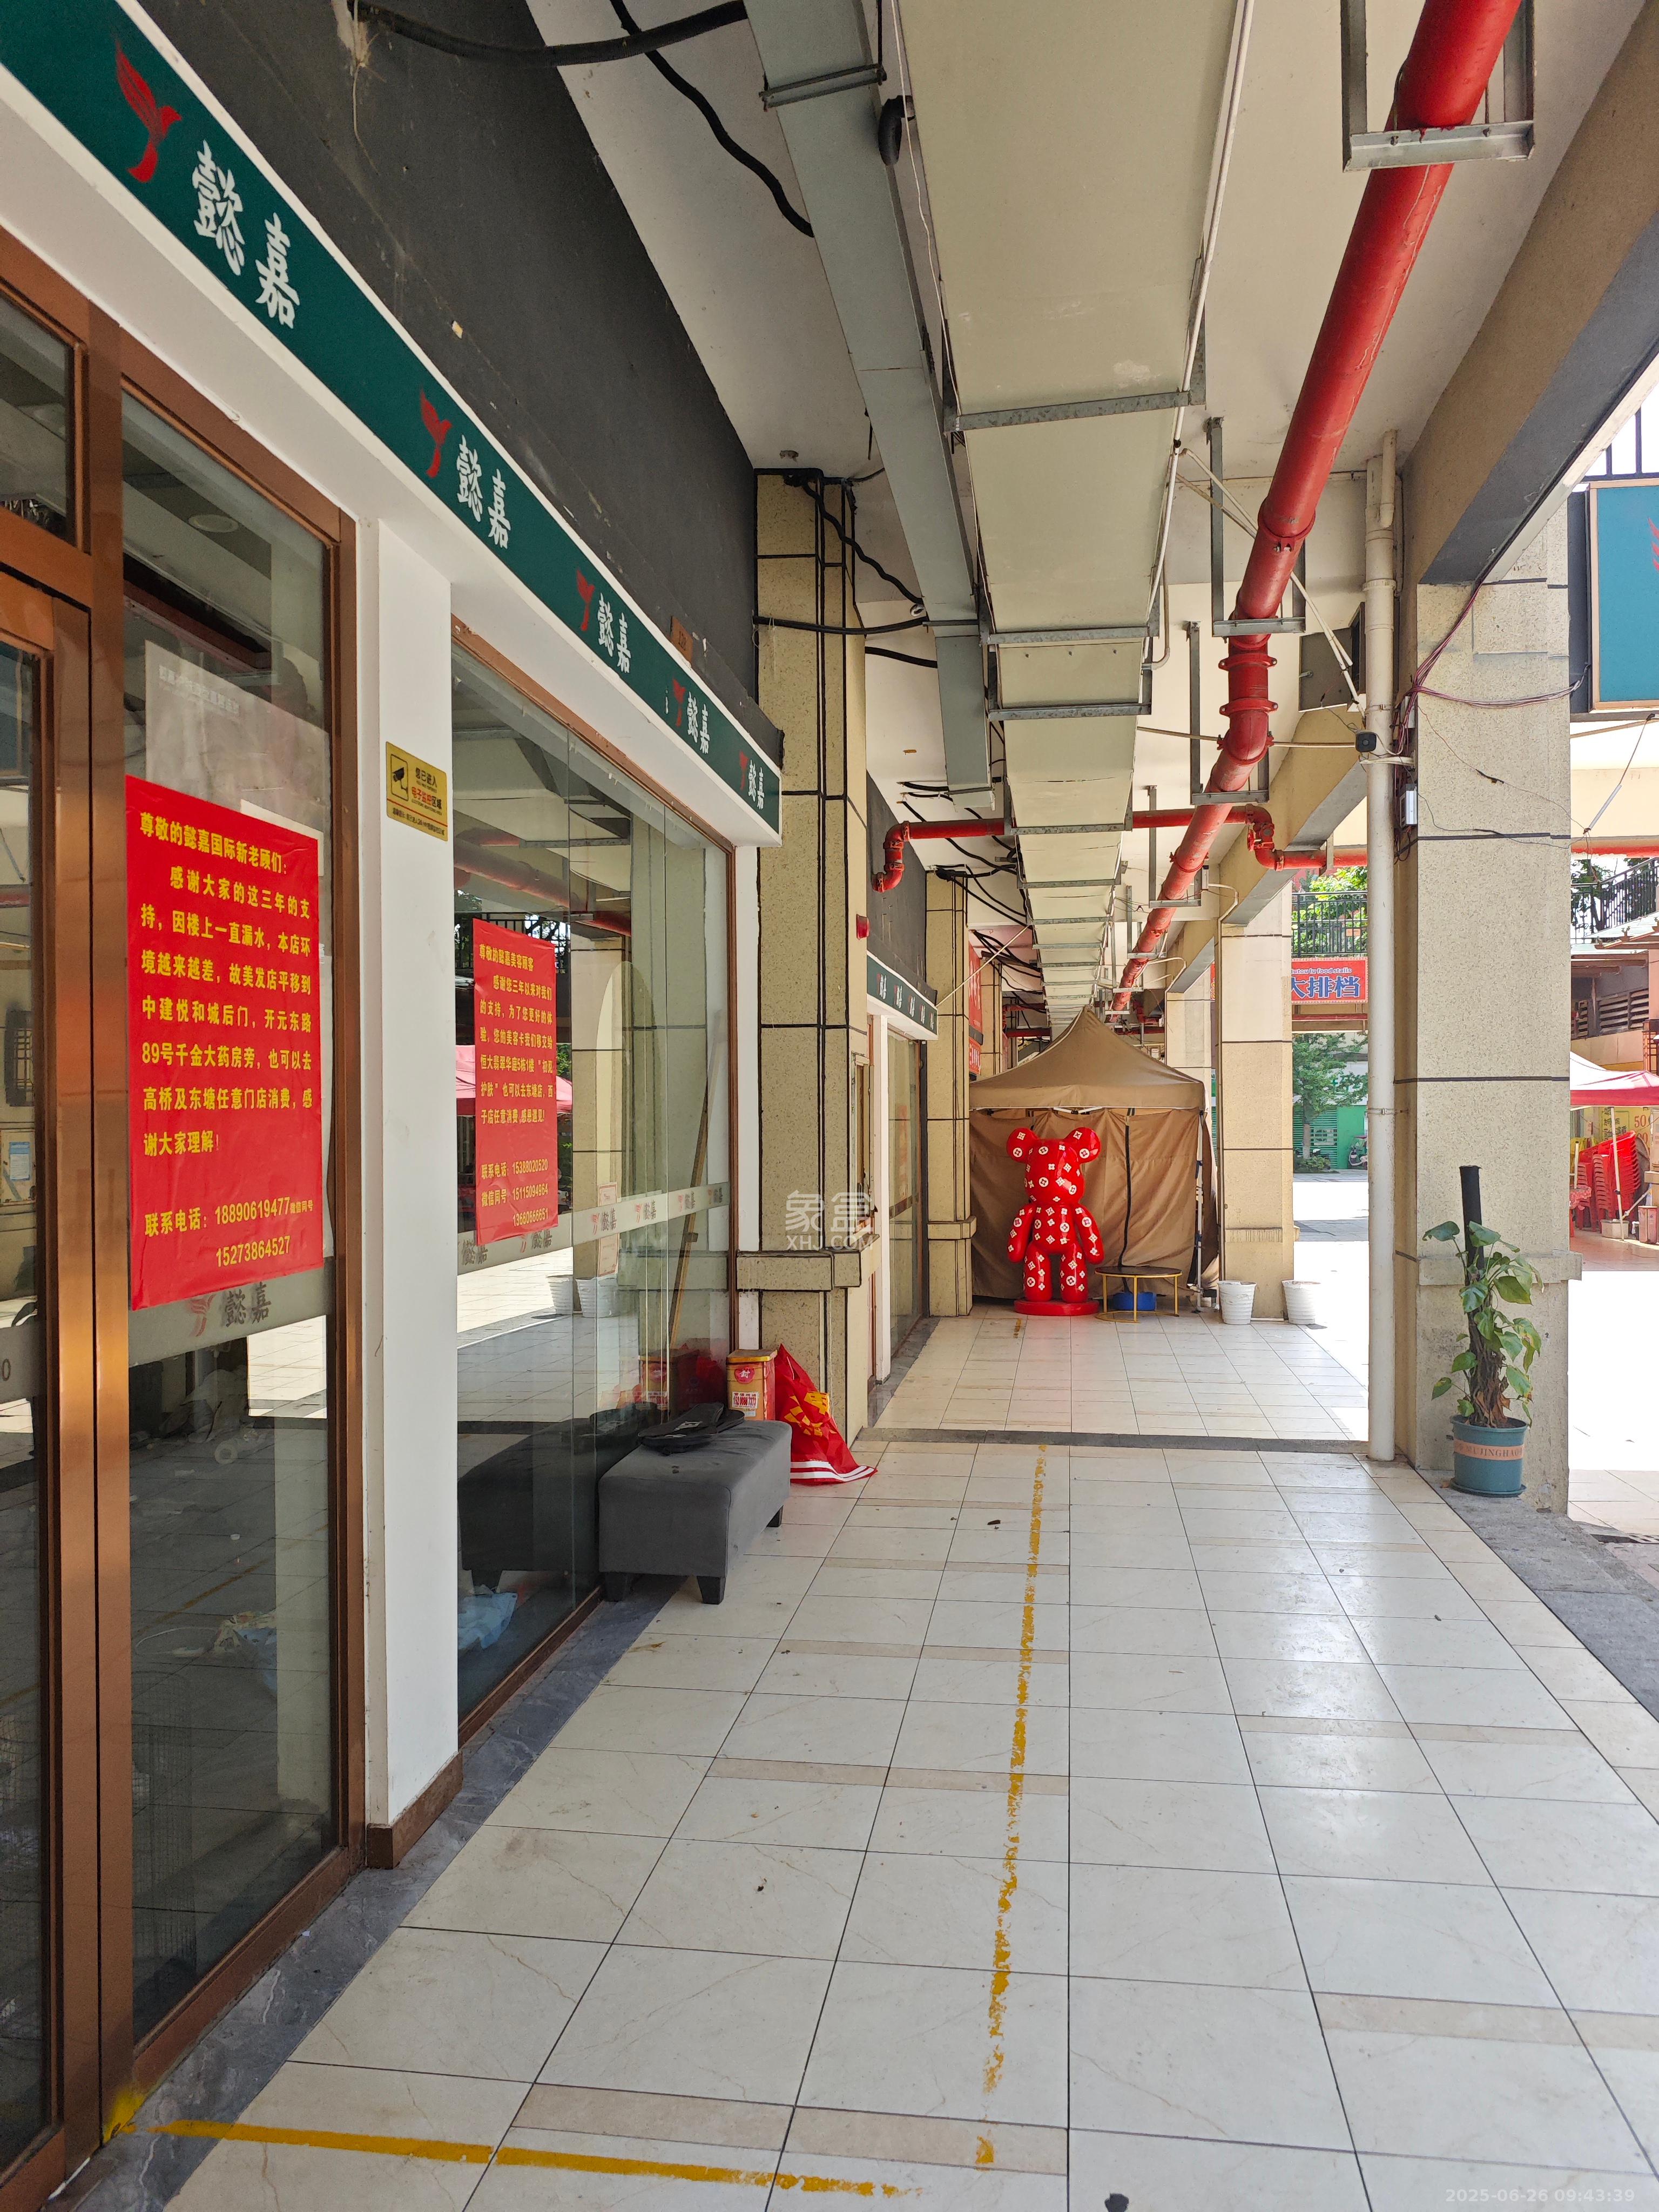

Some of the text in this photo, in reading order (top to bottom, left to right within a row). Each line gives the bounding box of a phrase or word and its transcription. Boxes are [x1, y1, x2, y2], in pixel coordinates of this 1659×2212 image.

[192, 139, 300, 329] 懿嘉
[456, 434, 511, 550] 懿嘉
[597, 592, 631, 674] 懿嘉
[686, 691, 710, 754] 懿嘉
[748, 759, 765, 811] 懿嘉
[170, 866, 311, 920] 感谢大家的这三年的支
[216, 1235, 291, 1267] 15273864527
[224, 1280, 271, 1328] 懿嘉
